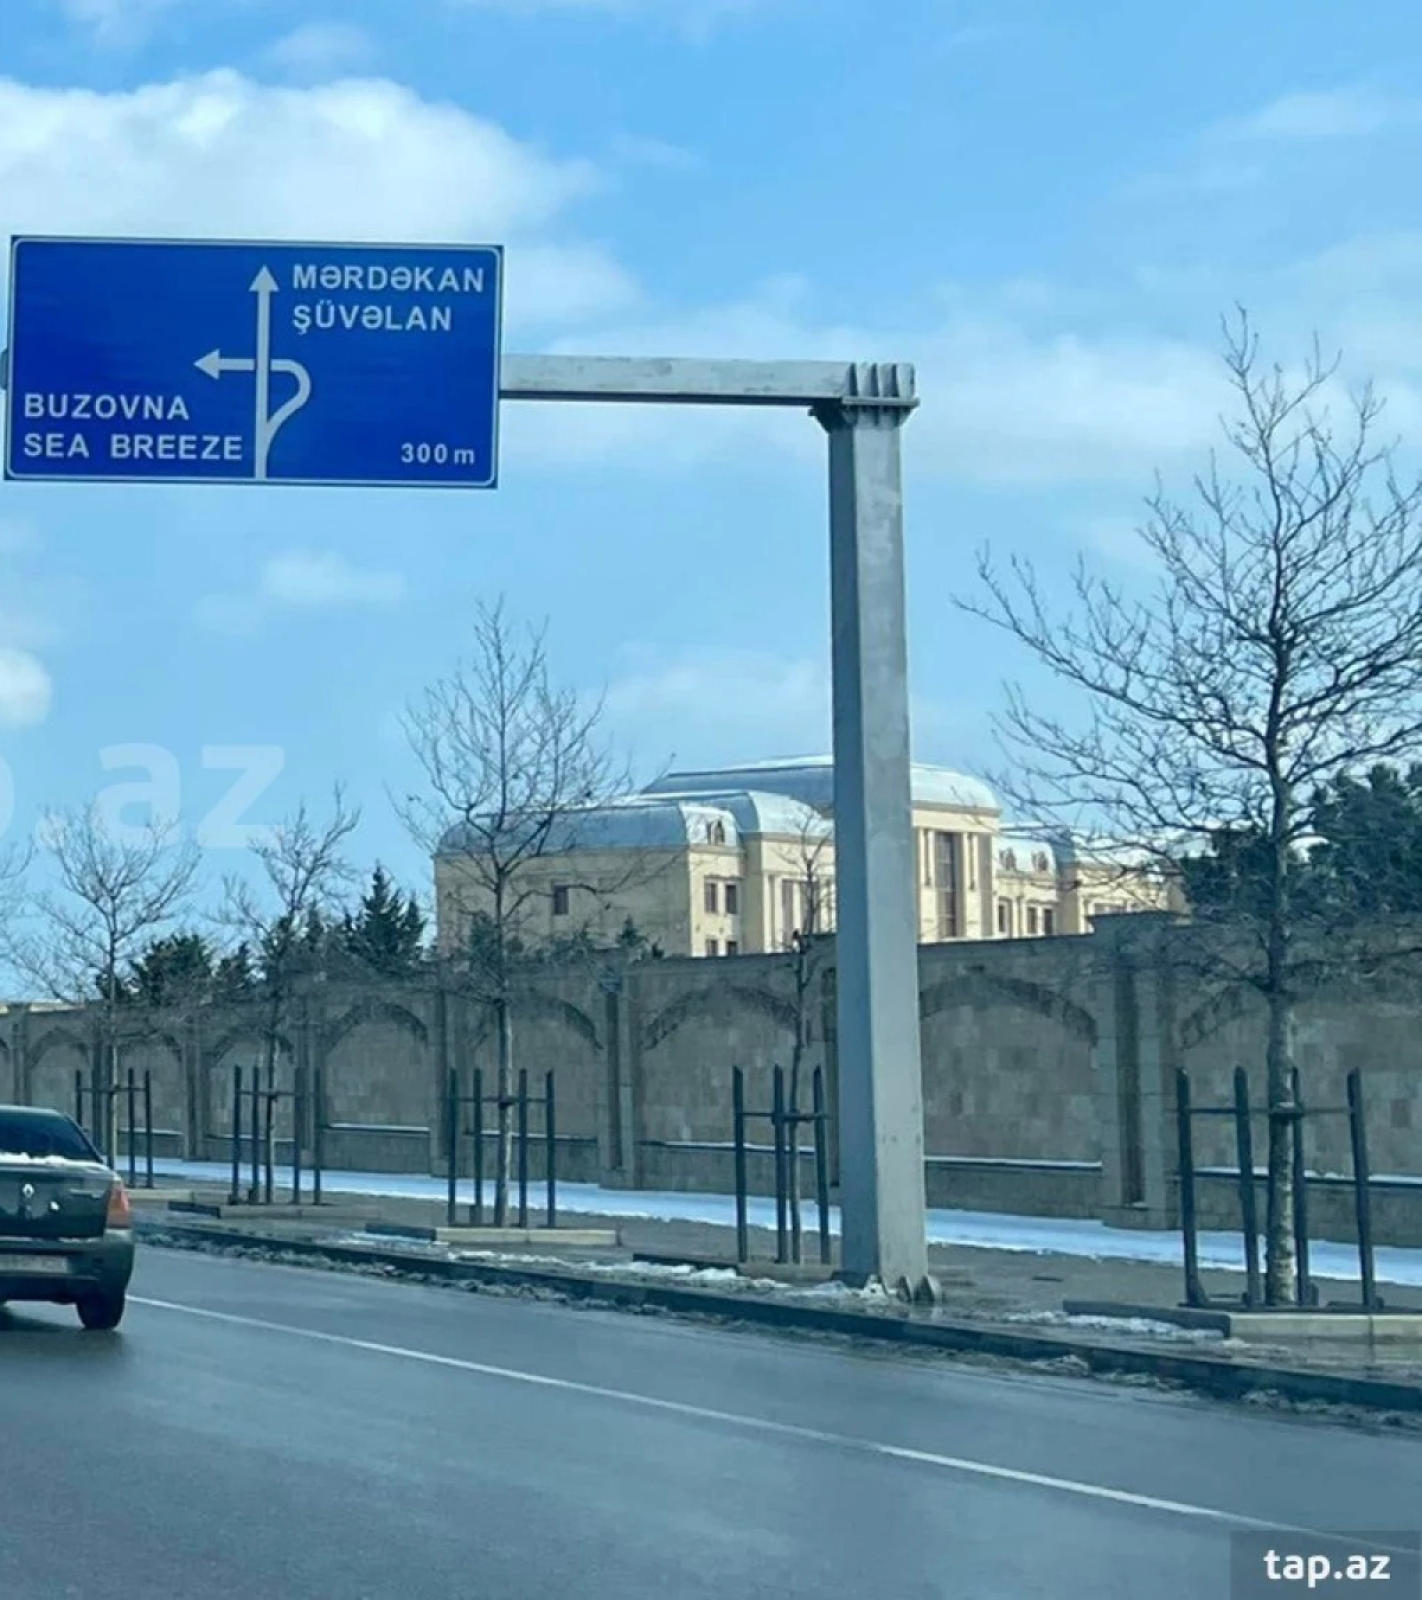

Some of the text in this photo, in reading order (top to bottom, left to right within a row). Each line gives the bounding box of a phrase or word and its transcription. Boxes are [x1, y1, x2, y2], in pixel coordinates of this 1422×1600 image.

[292, 264, 484, 293] MƏRDƏKAN
[292, 299, 452, 335] ŞÜVƏLAN
[23, 393, 190, 421] BUZOVNA
[23, 432, 243, 460] SEA BREEZE
